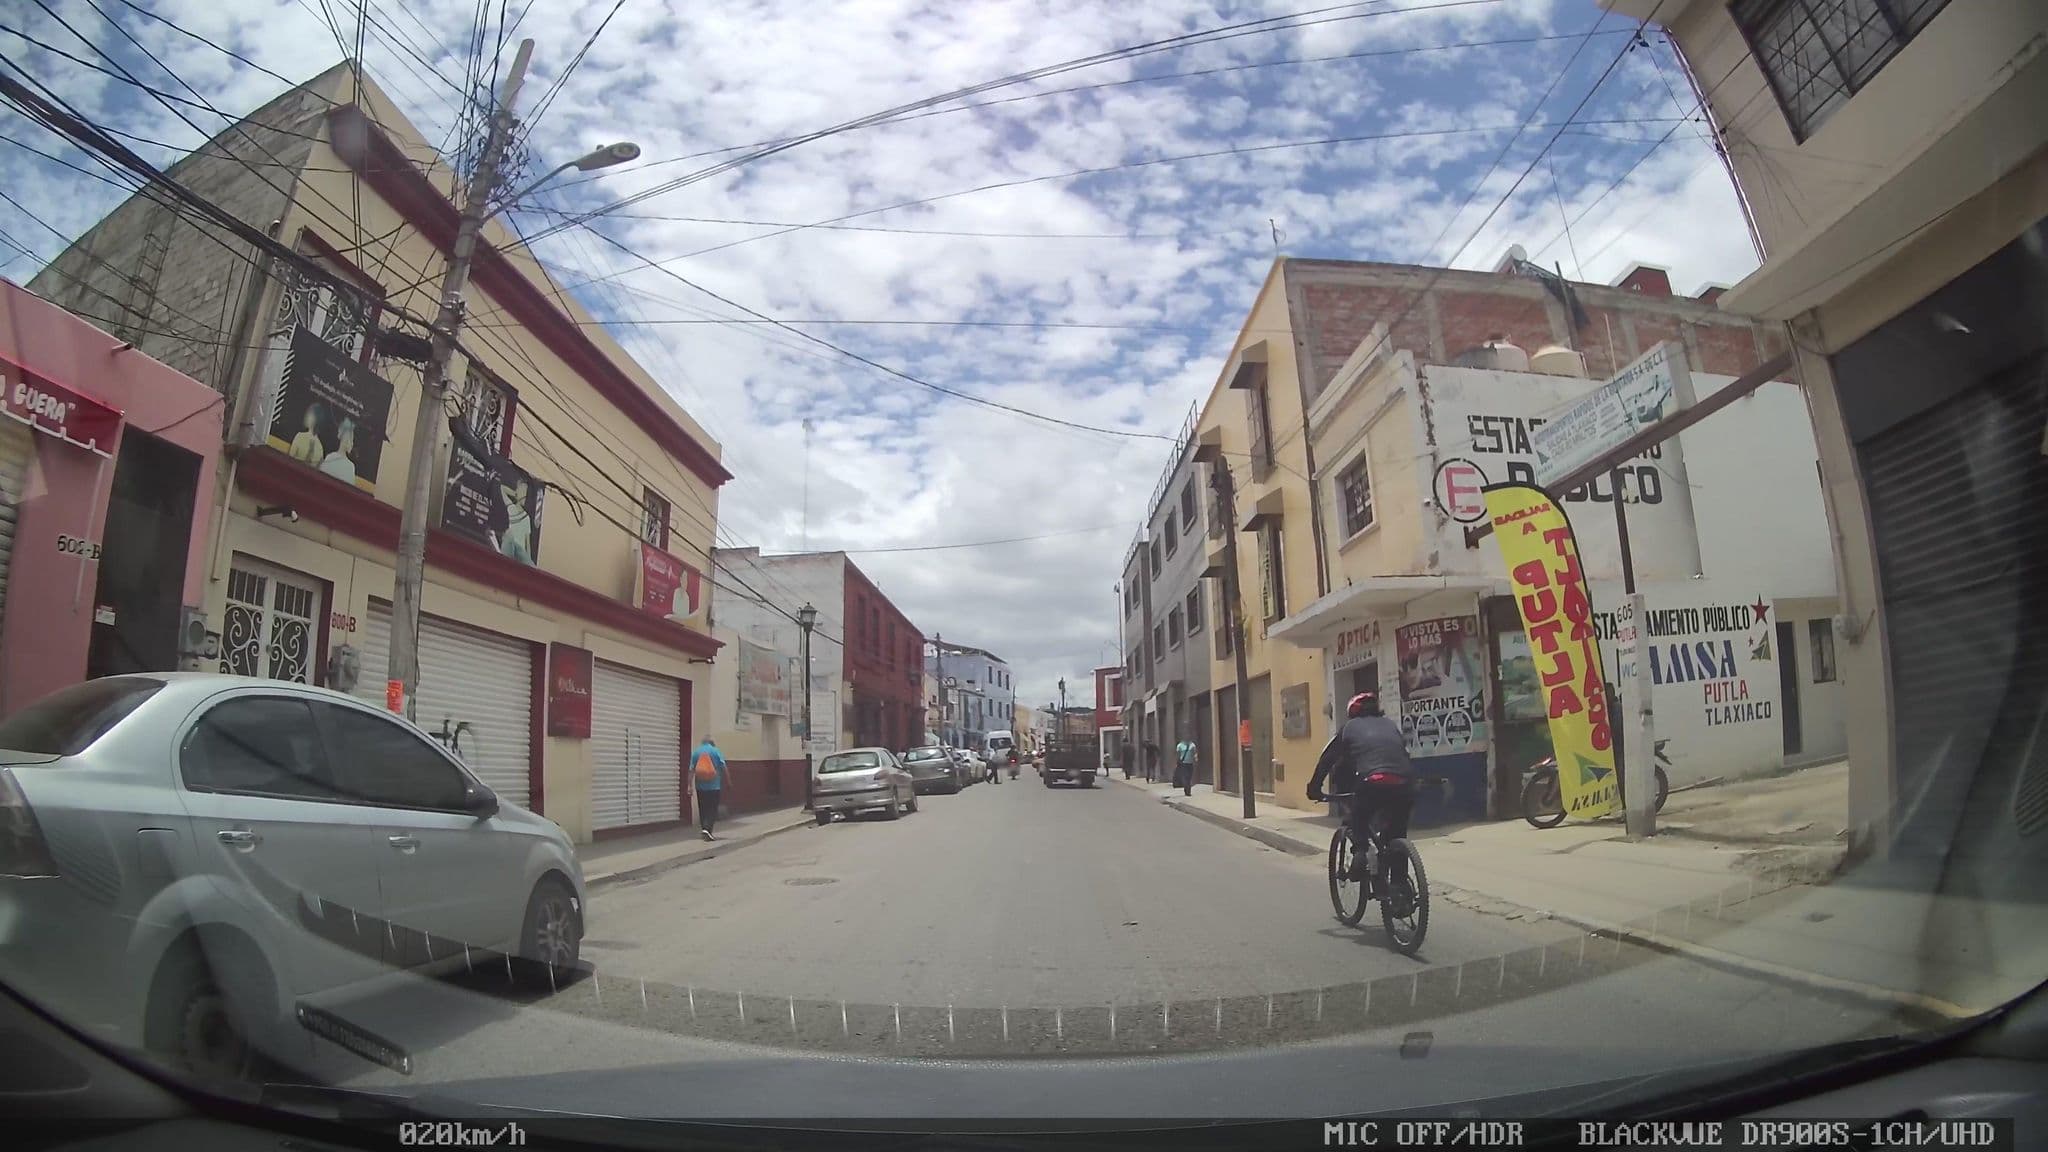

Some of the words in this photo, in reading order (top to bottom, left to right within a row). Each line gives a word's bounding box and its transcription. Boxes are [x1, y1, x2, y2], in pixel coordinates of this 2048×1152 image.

[57, 535, 101, 559] 602-B
[1616, 603, 1633, 623] 605
[1703, 602, 1751, 633] PÚBLICO
[1409, 621, 1440, 637] VISTA
[1444, 619, 1460, 632] ES
[1408, 636, 1419, 649] LO
[1420, 633, 1442, 648] MAS
[1621, 662, 1638, 678] WC
[1704, 679, 1749, 705] PUTLA
[1705, 701, 1772, 726] TLAXIACO
